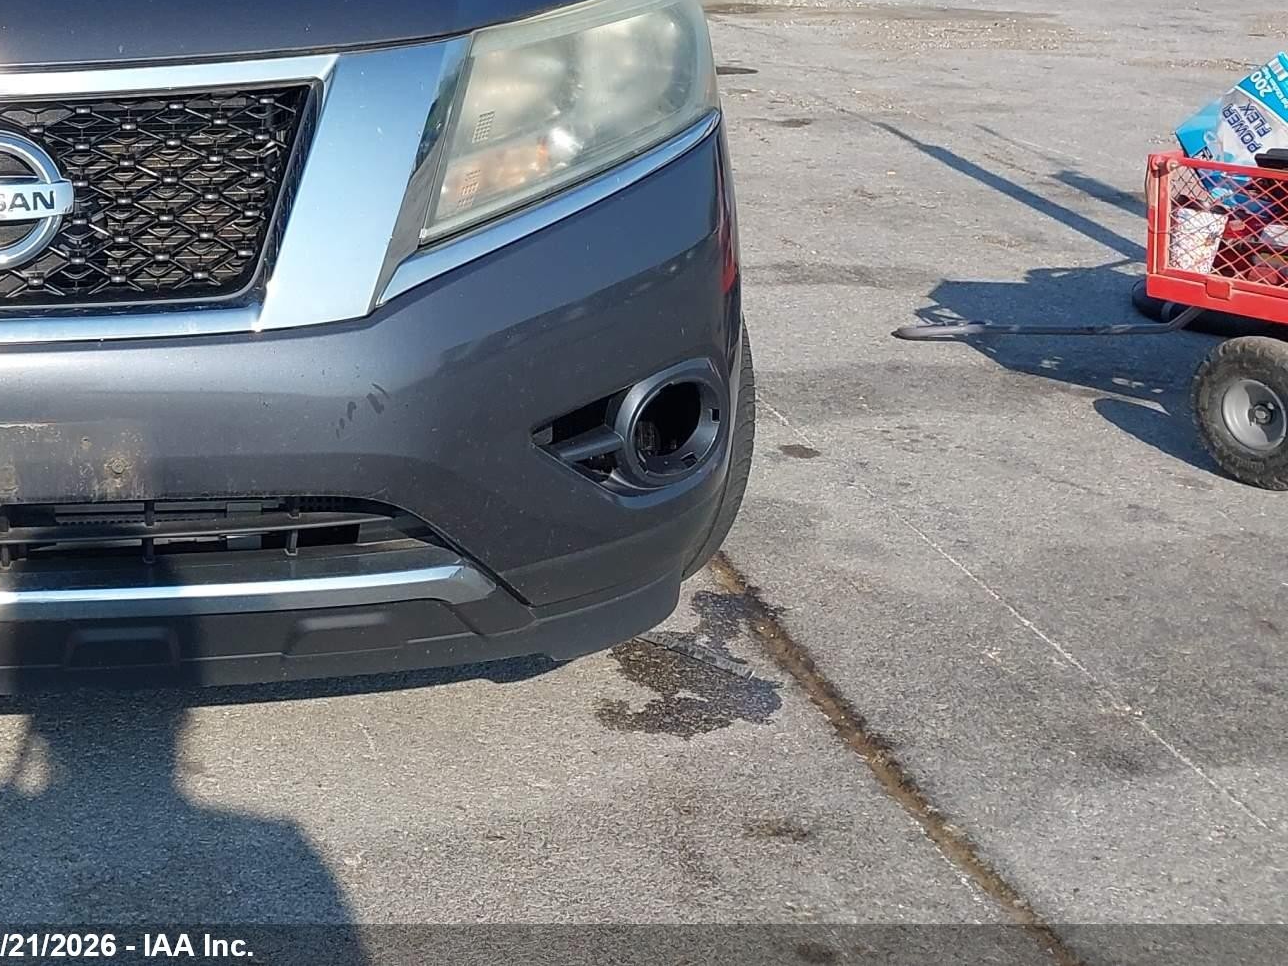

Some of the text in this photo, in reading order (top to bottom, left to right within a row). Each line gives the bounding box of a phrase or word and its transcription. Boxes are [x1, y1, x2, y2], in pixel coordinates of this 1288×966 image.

[1250, 70, 1273, 98] 200
[1221, 102, 1263, 153] POWER
[1238, 101, 1273, 138] FLEX
